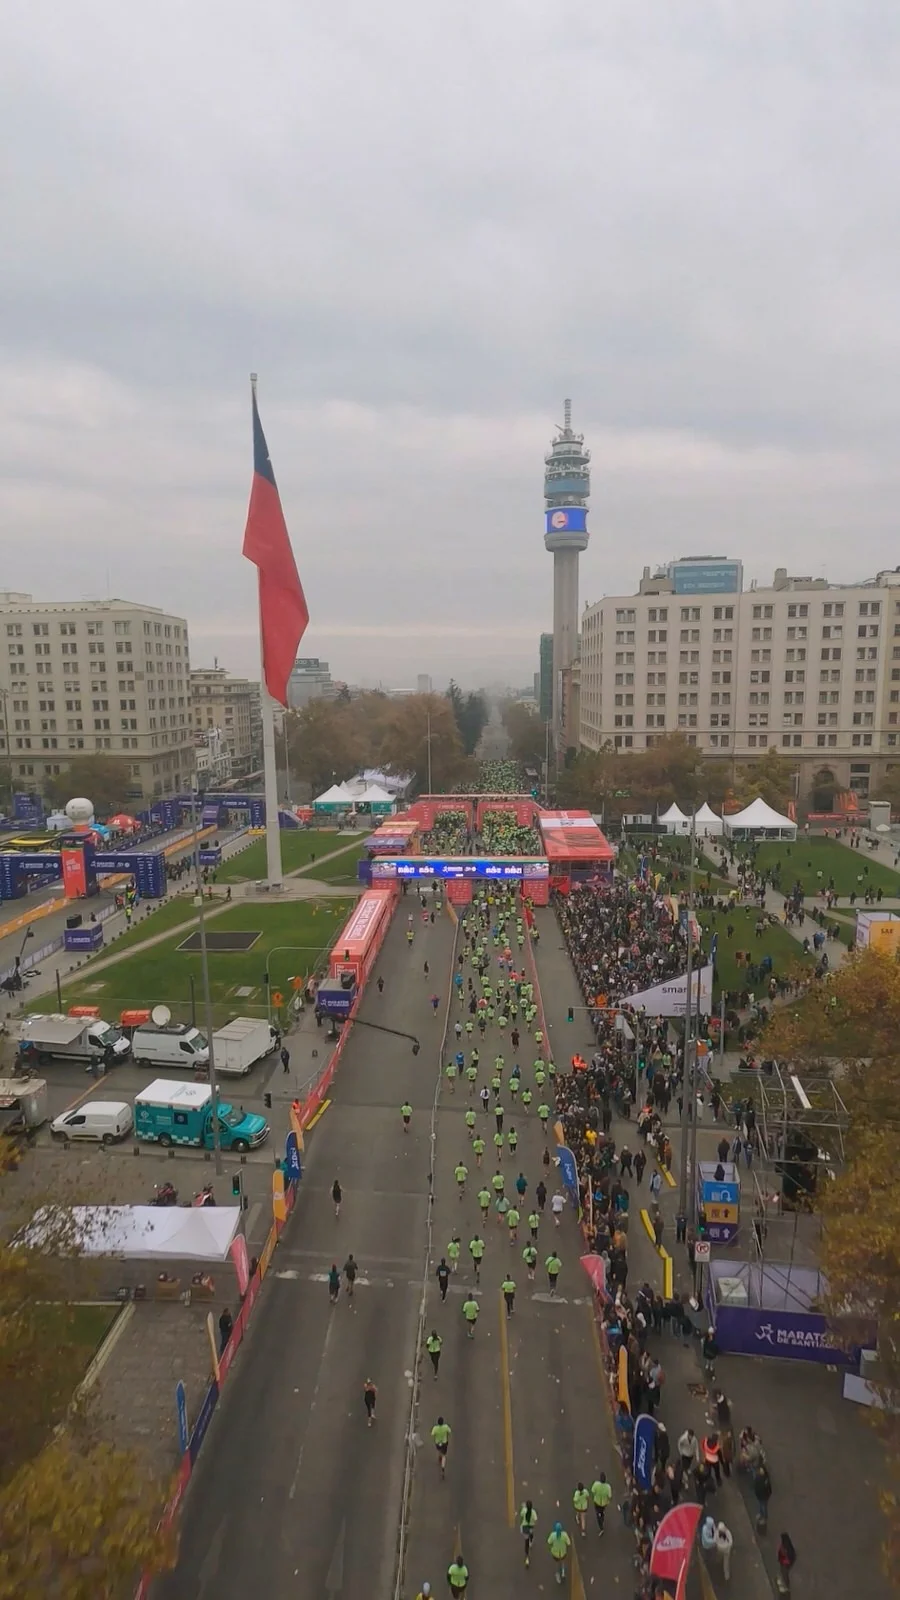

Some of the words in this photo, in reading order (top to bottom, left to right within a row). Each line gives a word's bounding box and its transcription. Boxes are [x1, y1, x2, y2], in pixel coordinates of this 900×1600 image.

[662, 986, 690, 994] smar
[777, 1329, 832, 1342] MARAT
[777, 1336, 789, 1344] DE
